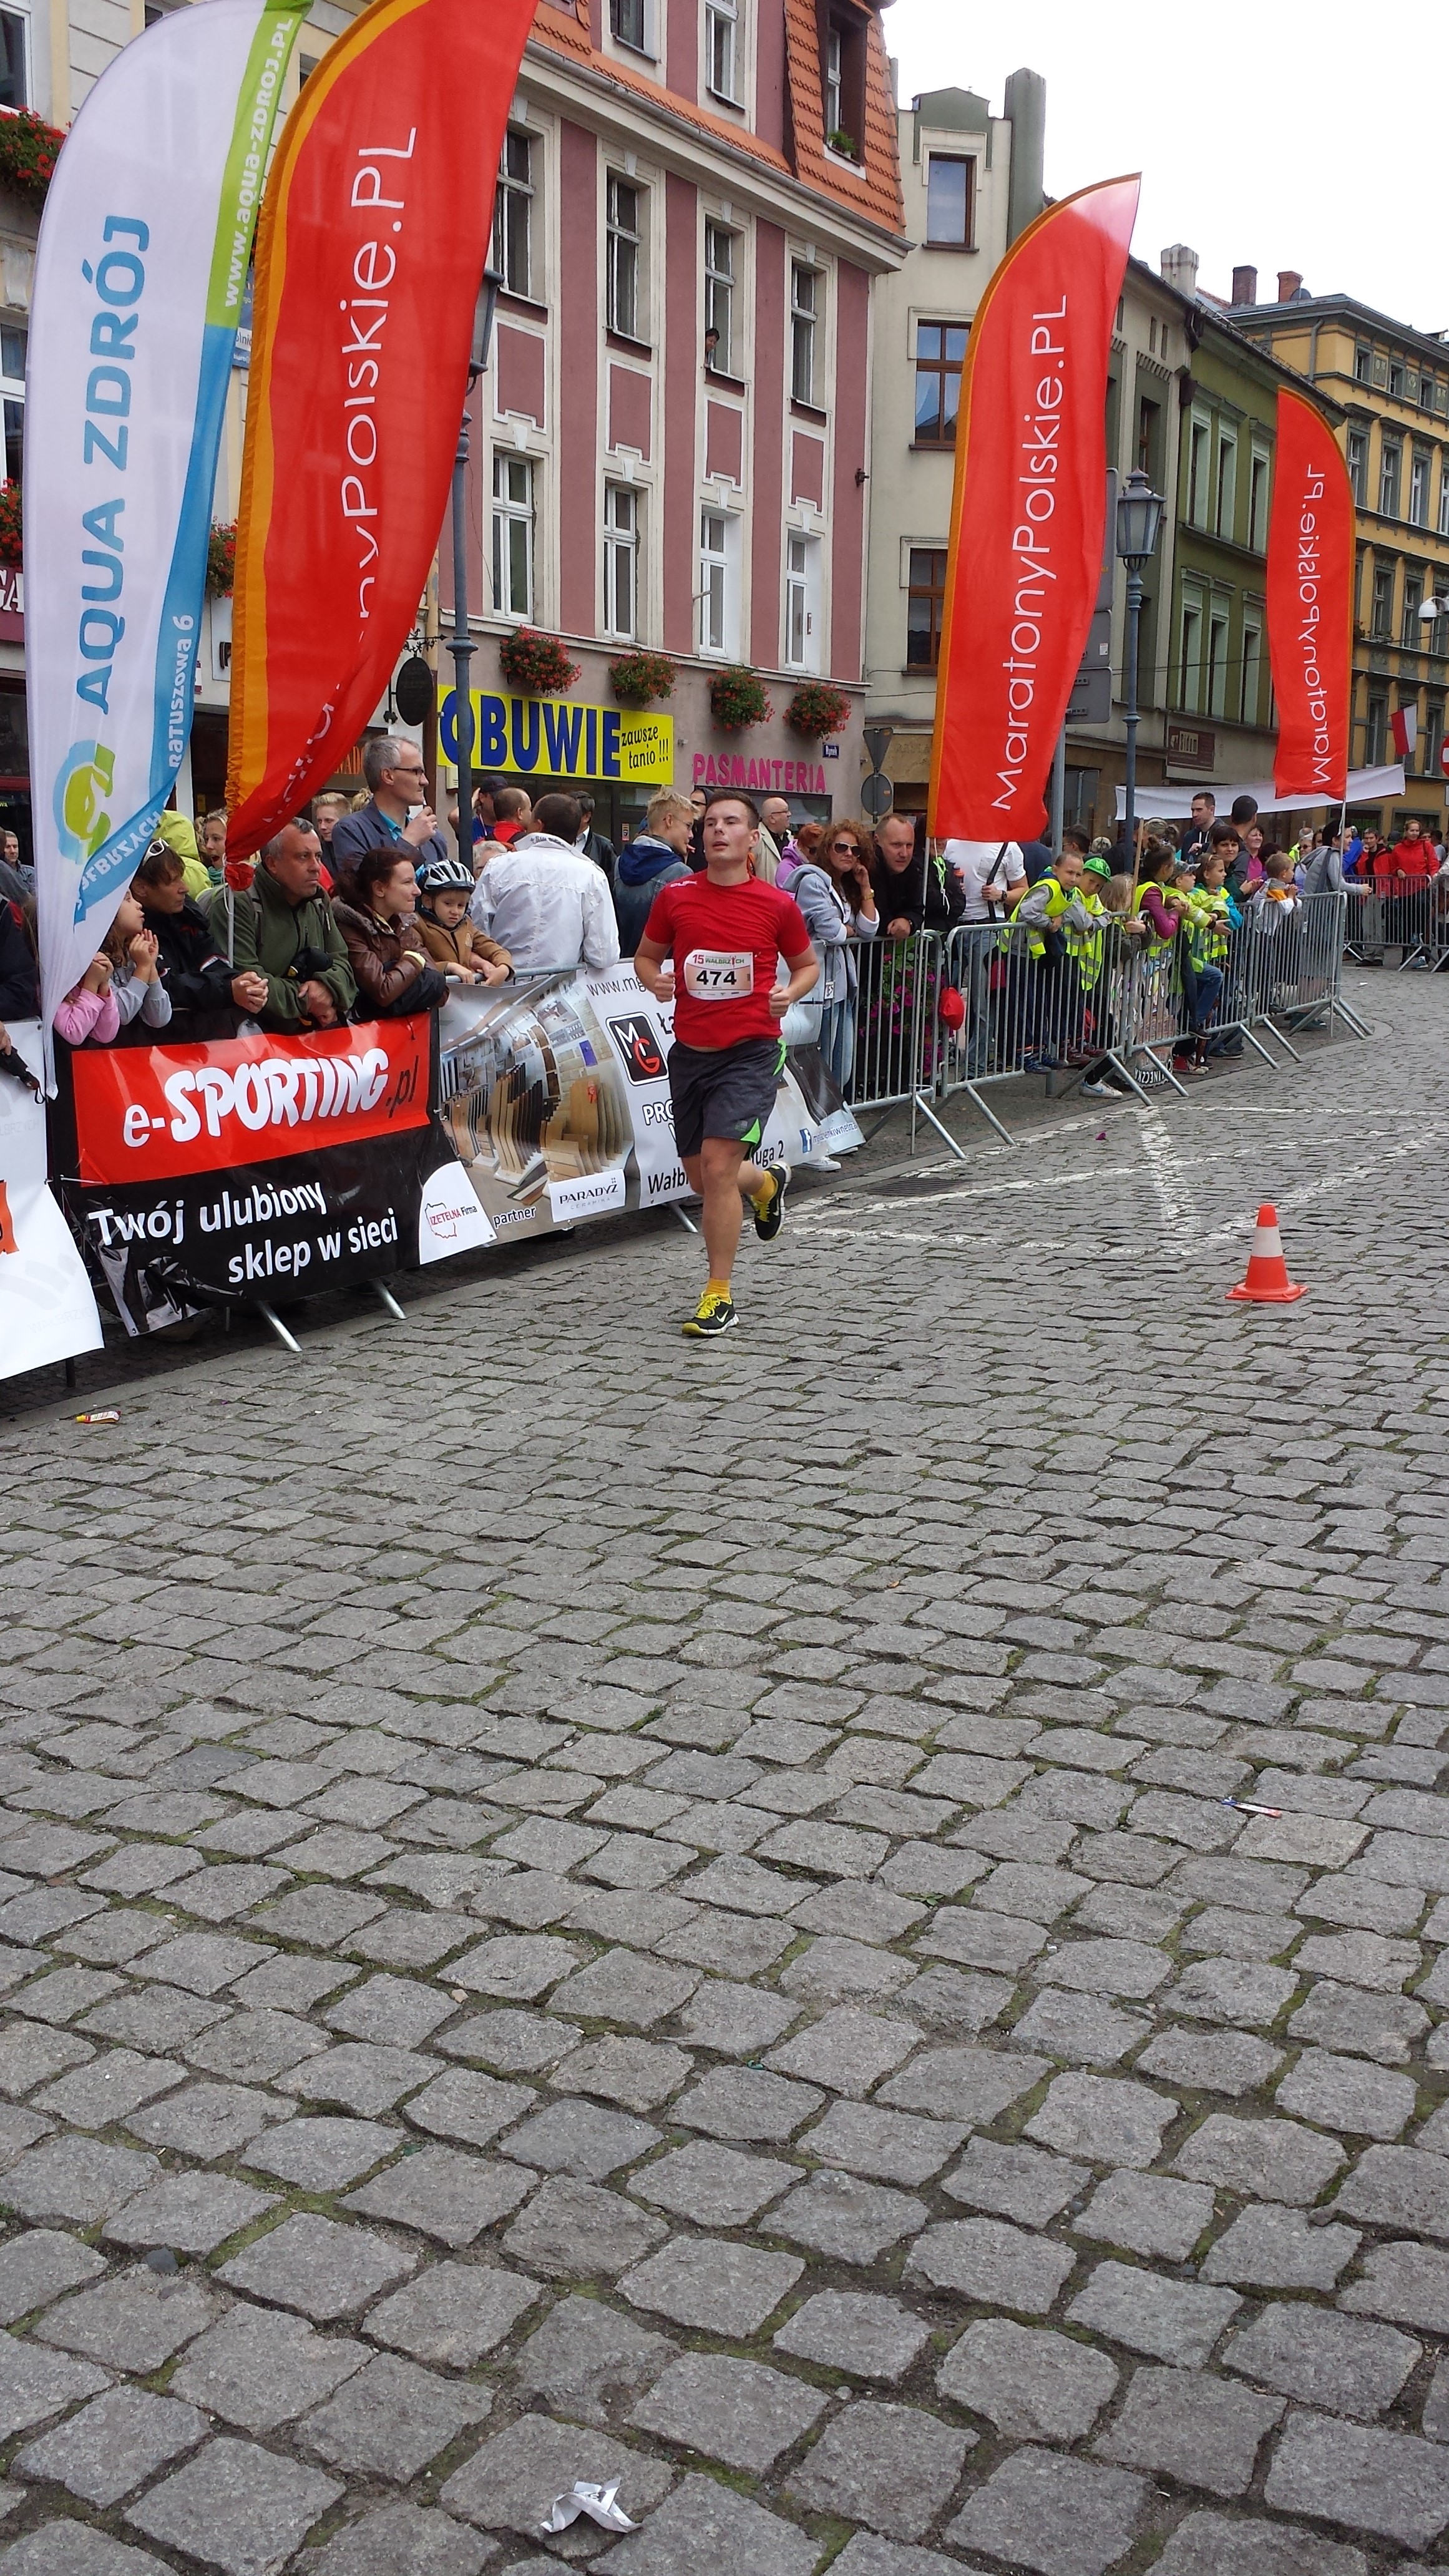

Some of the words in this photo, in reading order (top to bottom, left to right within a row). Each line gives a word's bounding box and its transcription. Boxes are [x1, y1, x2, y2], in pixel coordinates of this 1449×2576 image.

[82, 215, 150, 471] ZDRÓJ
[991, 294, 1068, 811] MaratonyPolskie.PL
[77, 499, 125, 715] AQUA
[173, 615, 194, 632] 6
[439, 689, 622, 778] OBUWIE
[621, 724, 659, 748] zawsze
[628, 748, 656, 770] tanio
[693, 753, 826, 794] PASMANTERIA
[693, 954, 705, 964] 15
[696, 970, 737, 986] 474
[778, 1140, 784, 1159] 2
[89, 1200, 184, 1247] Twój
[200, 1181, 326, 1233] ulubiony
[494, 1206, 537, 1227] partner
[228, 1235, 311, 1284] sklep
[318, 1232, 341, 1261] w
[349, 1208, 398, 1254] sieci
